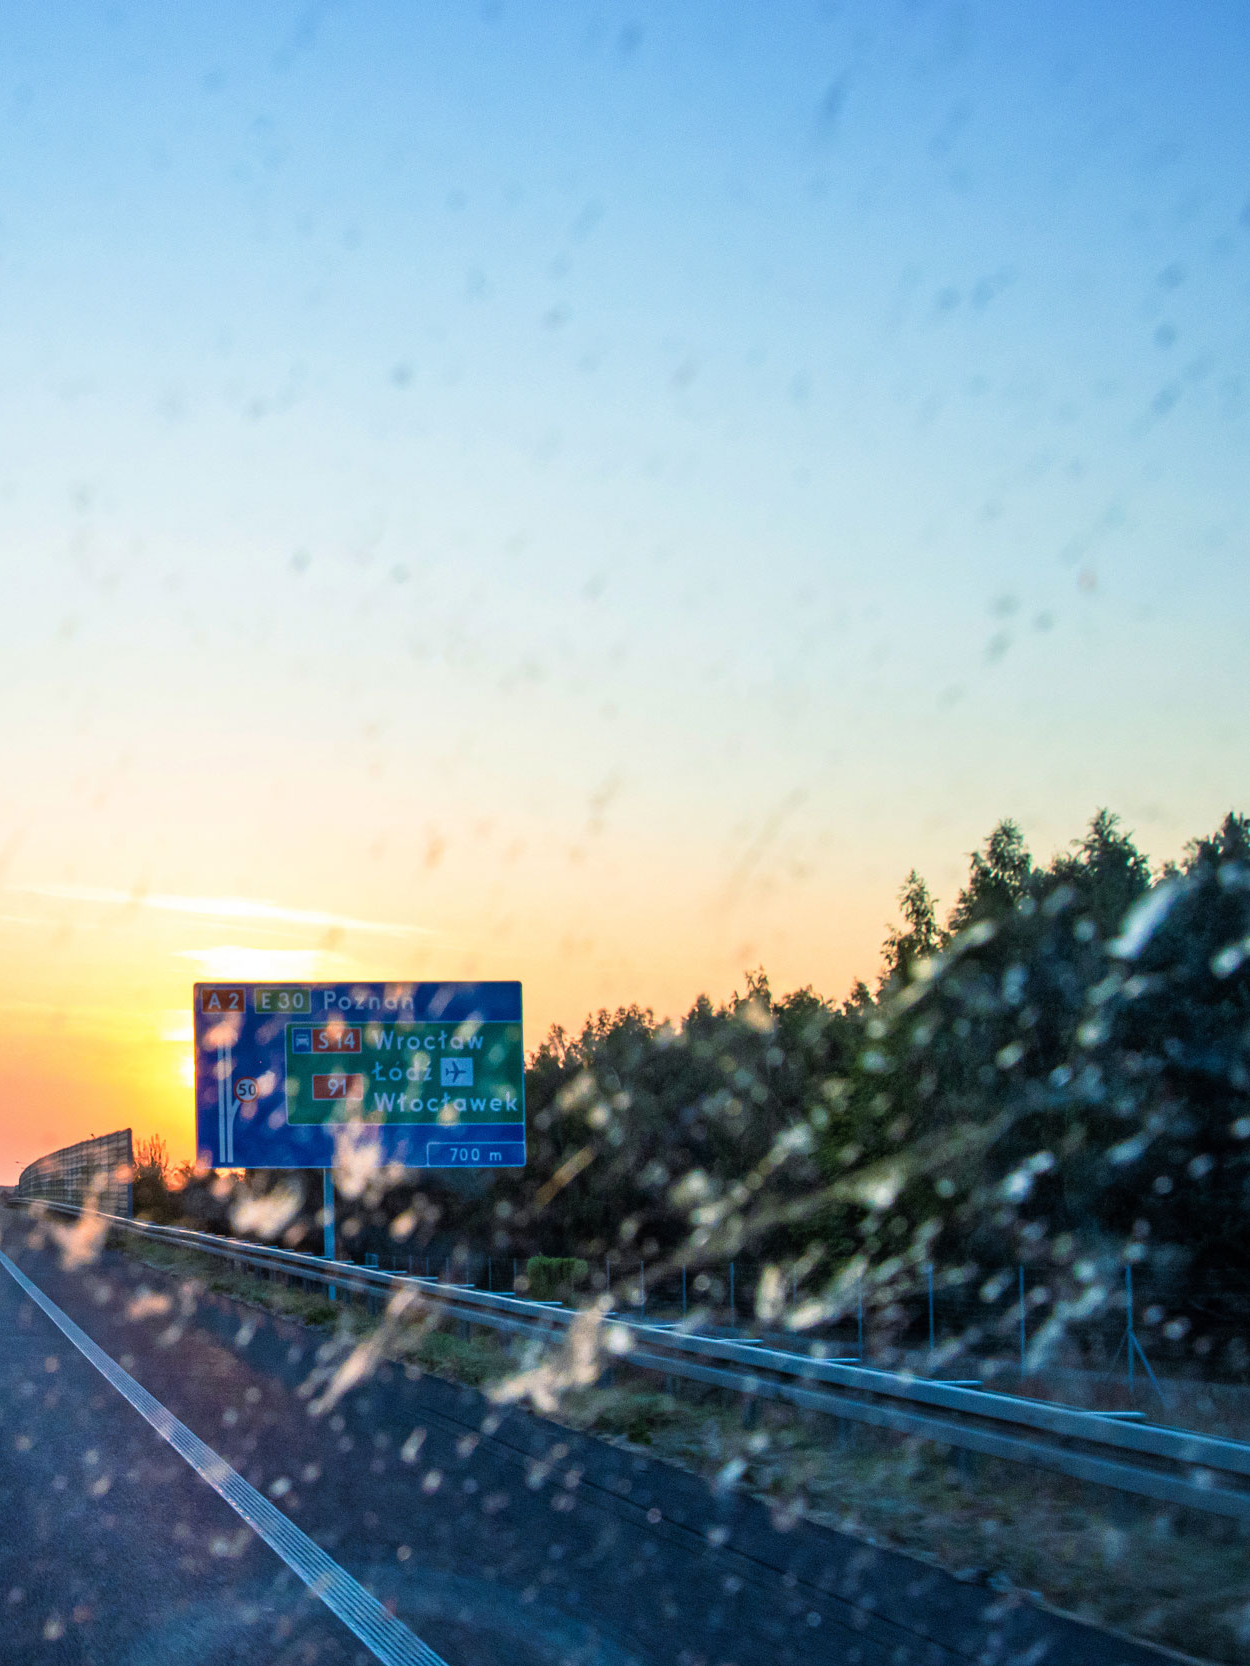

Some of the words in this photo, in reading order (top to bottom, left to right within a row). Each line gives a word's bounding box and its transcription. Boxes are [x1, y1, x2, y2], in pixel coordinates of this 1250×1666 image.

[208, 993, 220, 1009] A
[229, 992, 240, 1009] 2
[262, 993, 271, 1009] E
[278, 992, 304, 1009] 30
[318, 1032, 328, 1049] S
[374, 1031, 483, 1050] Wrocław
[238, 1083, 256, 1096] 50
[327, 1079, 347, 1096] 91
[374, 1092, 518, 1112] Włocławek
[450, 1148, 480, 1161] 700
[489, 1151, 502, 1161] m
